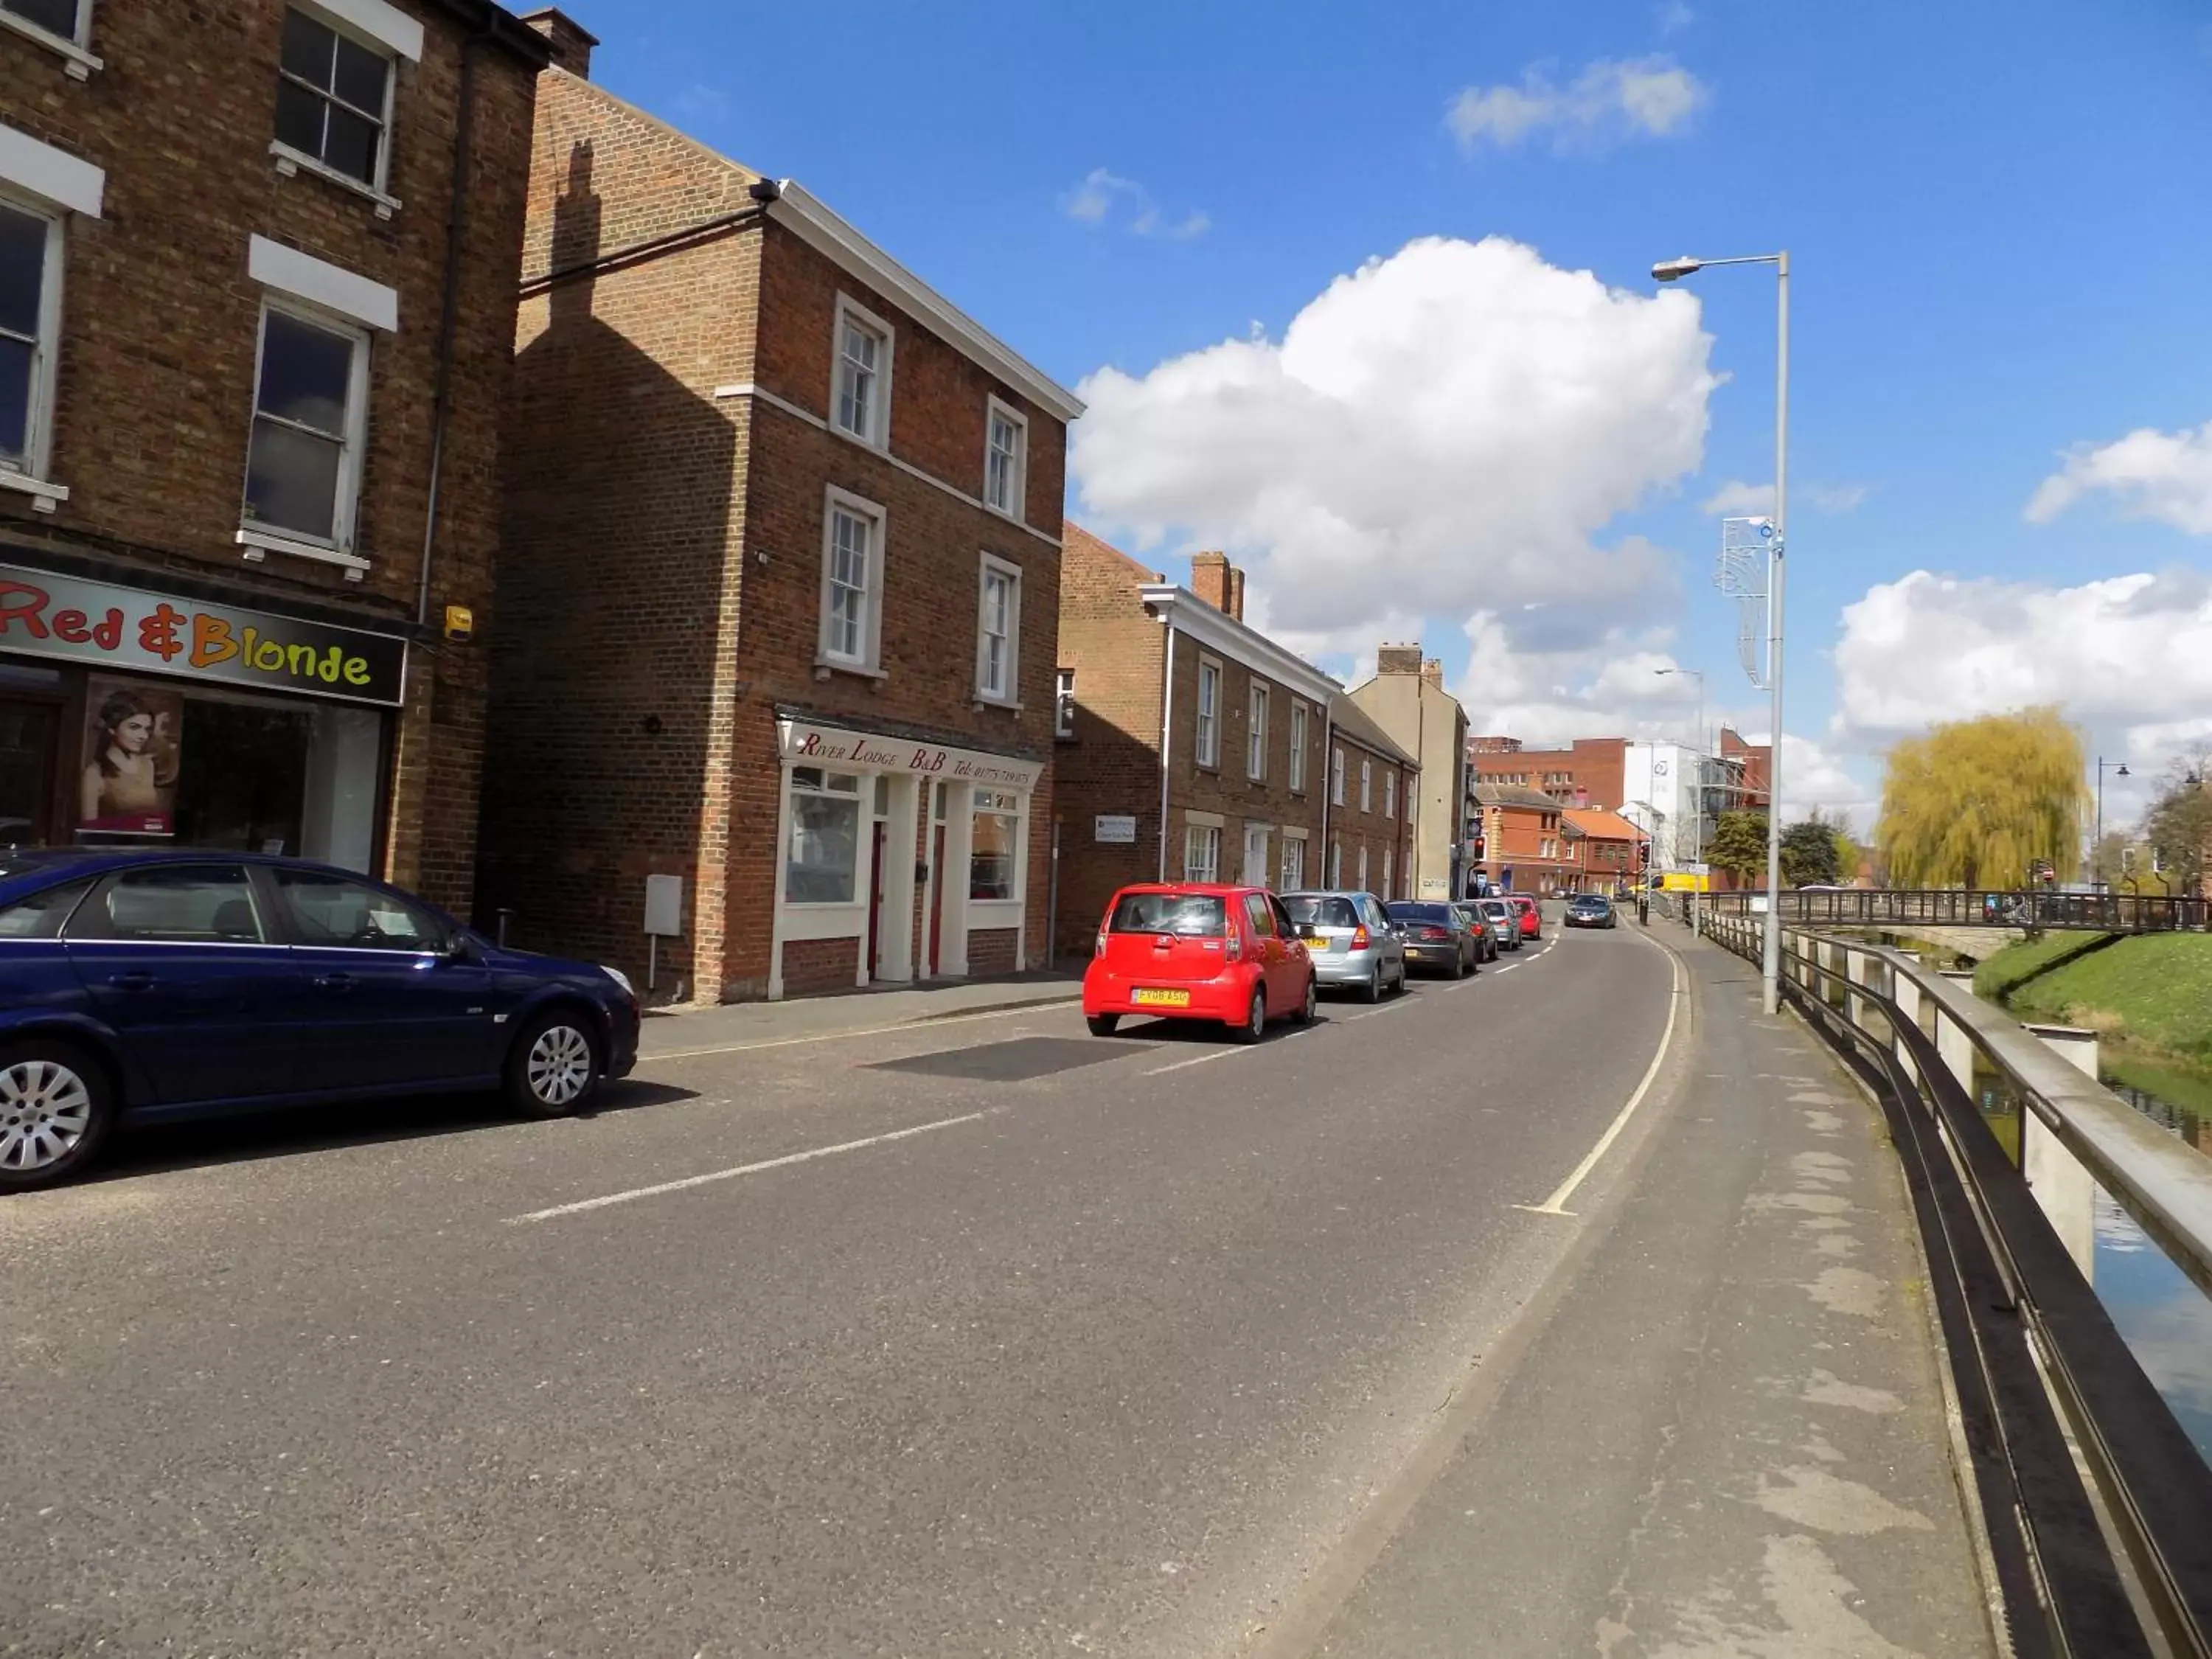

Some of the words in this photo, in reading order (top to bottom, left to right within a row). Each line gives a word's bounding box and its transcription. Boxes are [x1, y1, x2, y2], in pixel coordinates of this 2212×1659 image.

[0, 580, 125, 650] Red
[138, 602, 188, 663] &
[189, 613, 371, 685] Blonde
[908, 748, 947, 771] B&B
